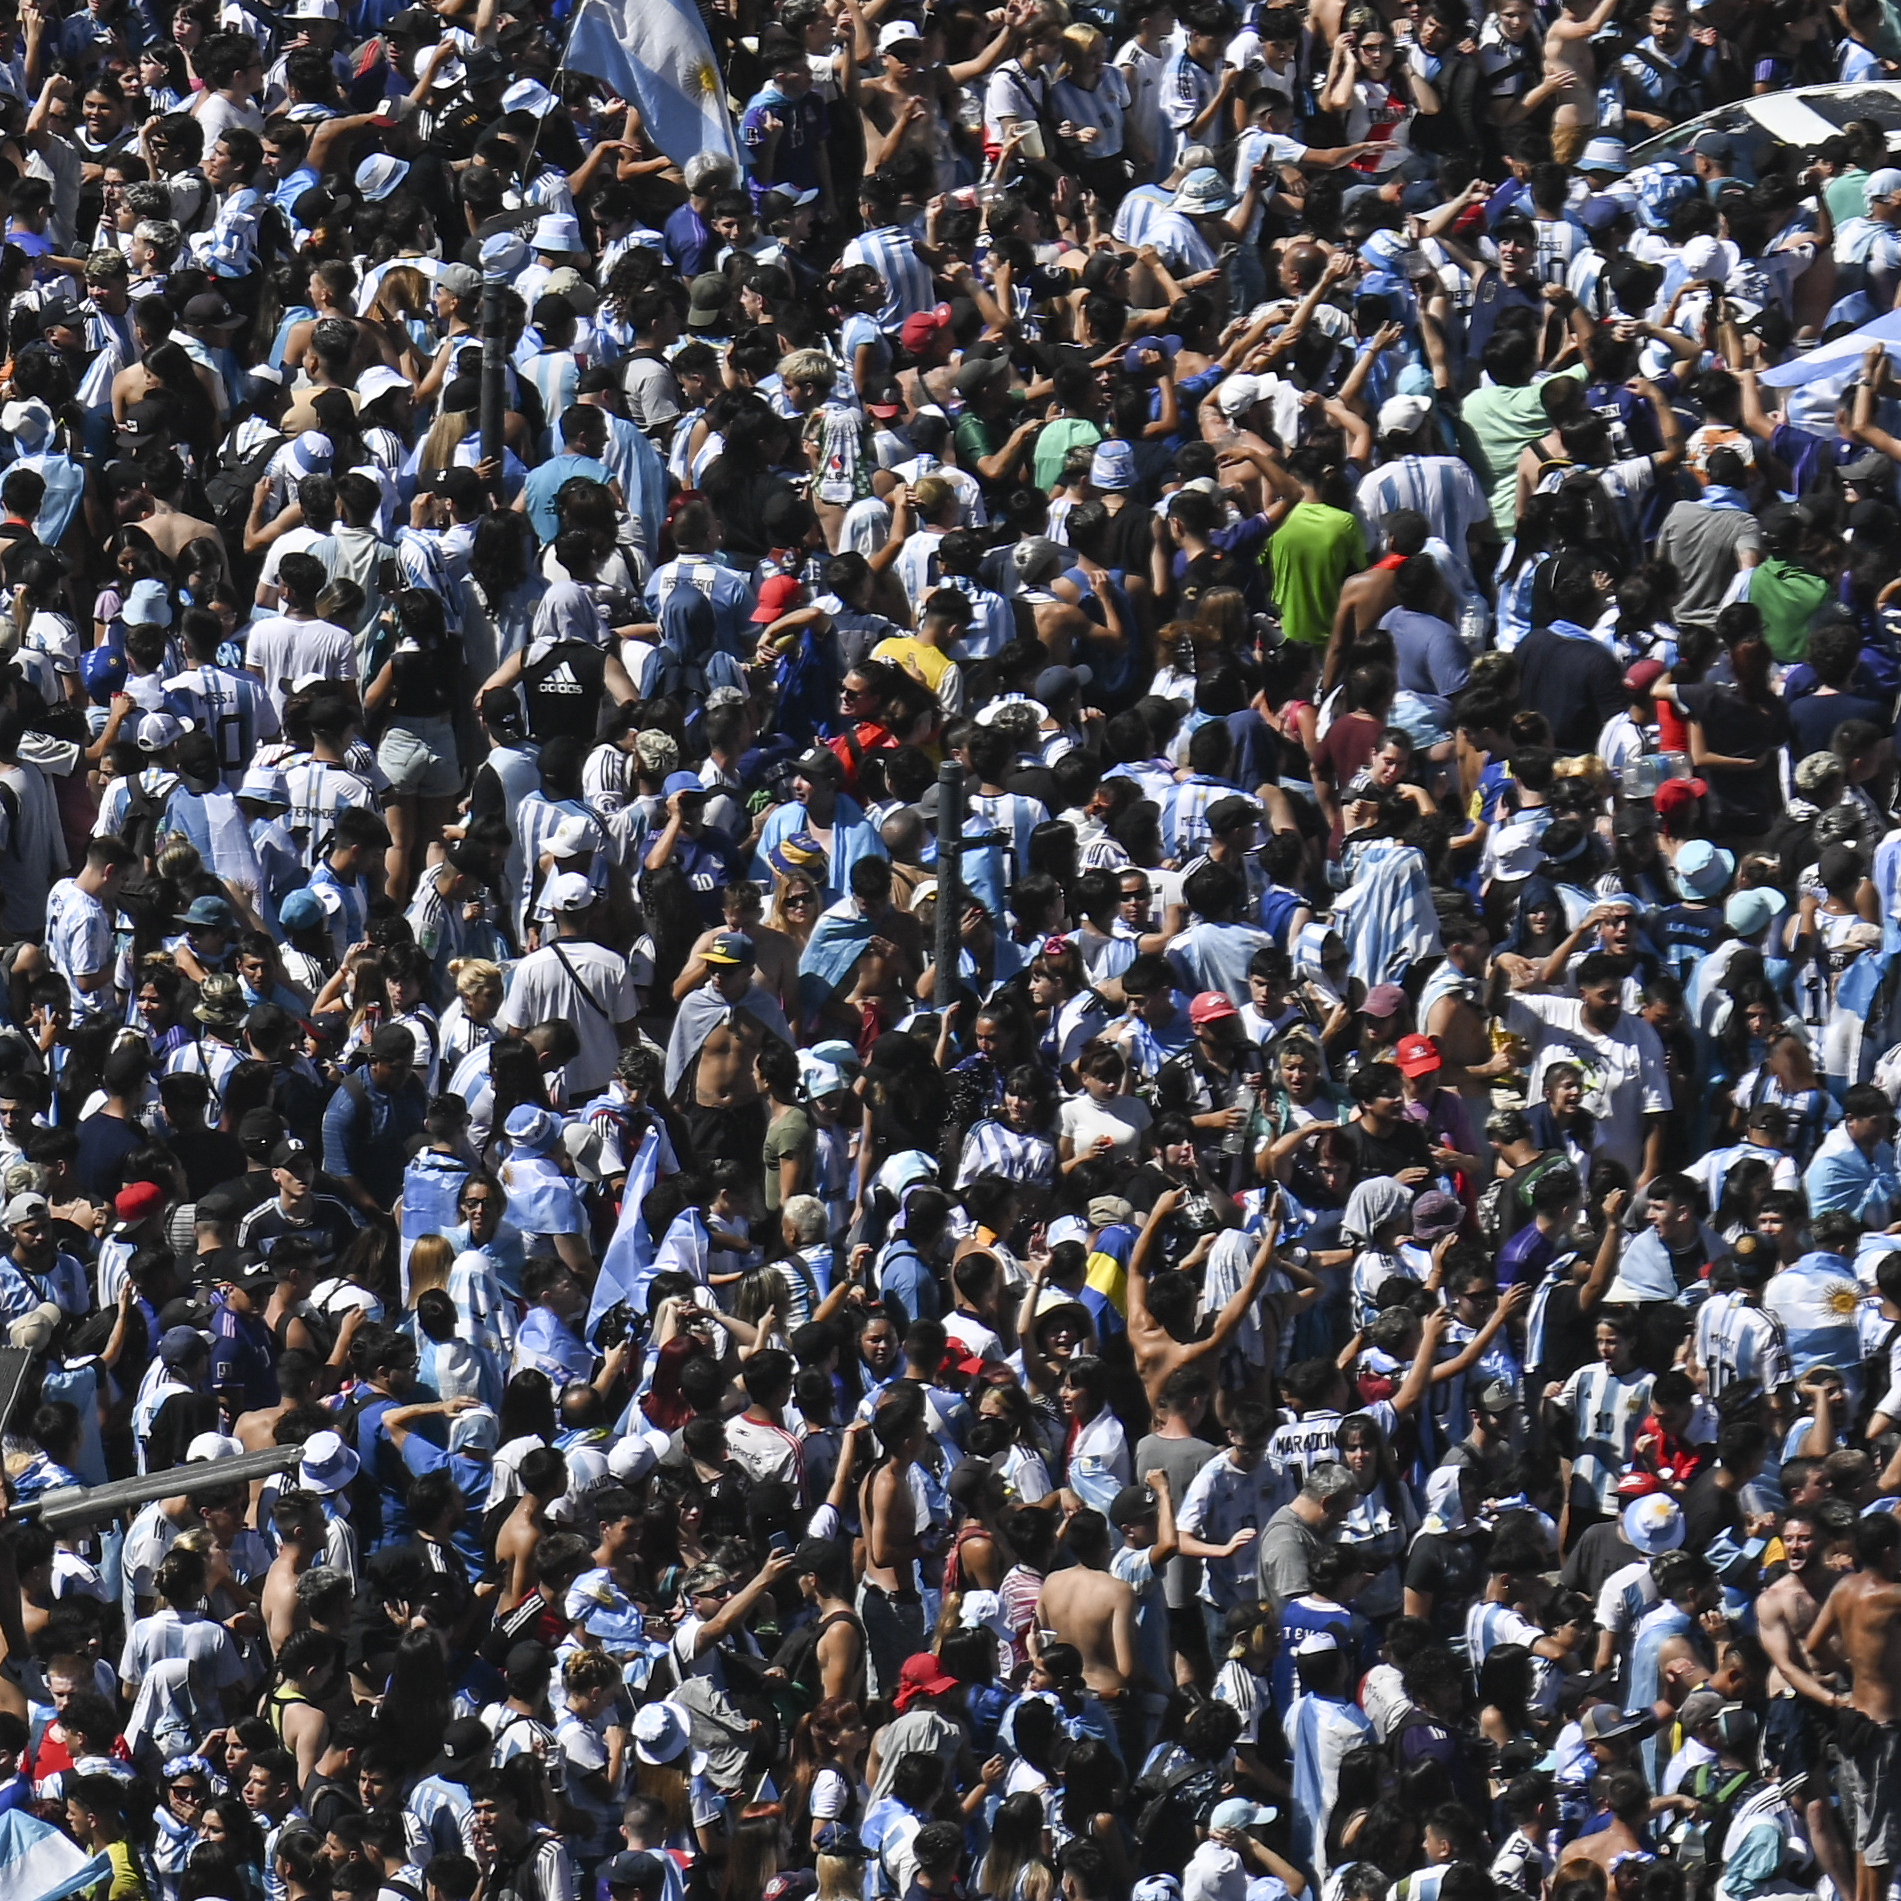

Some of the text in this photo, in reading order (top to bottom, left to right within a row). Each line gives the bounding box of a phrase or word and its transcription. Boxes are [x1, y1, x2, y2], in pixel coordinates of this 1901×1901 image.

[541, 681, 584, 696] adidas
[200, 691, 236, 706] MESSI
[1182, 815, 1209, 830] MESS
[692, 873, 713, 892] 10
[1593, 1411, 1615, 1435] 10
[1273, 1431, 1338, 1458] MARADON
